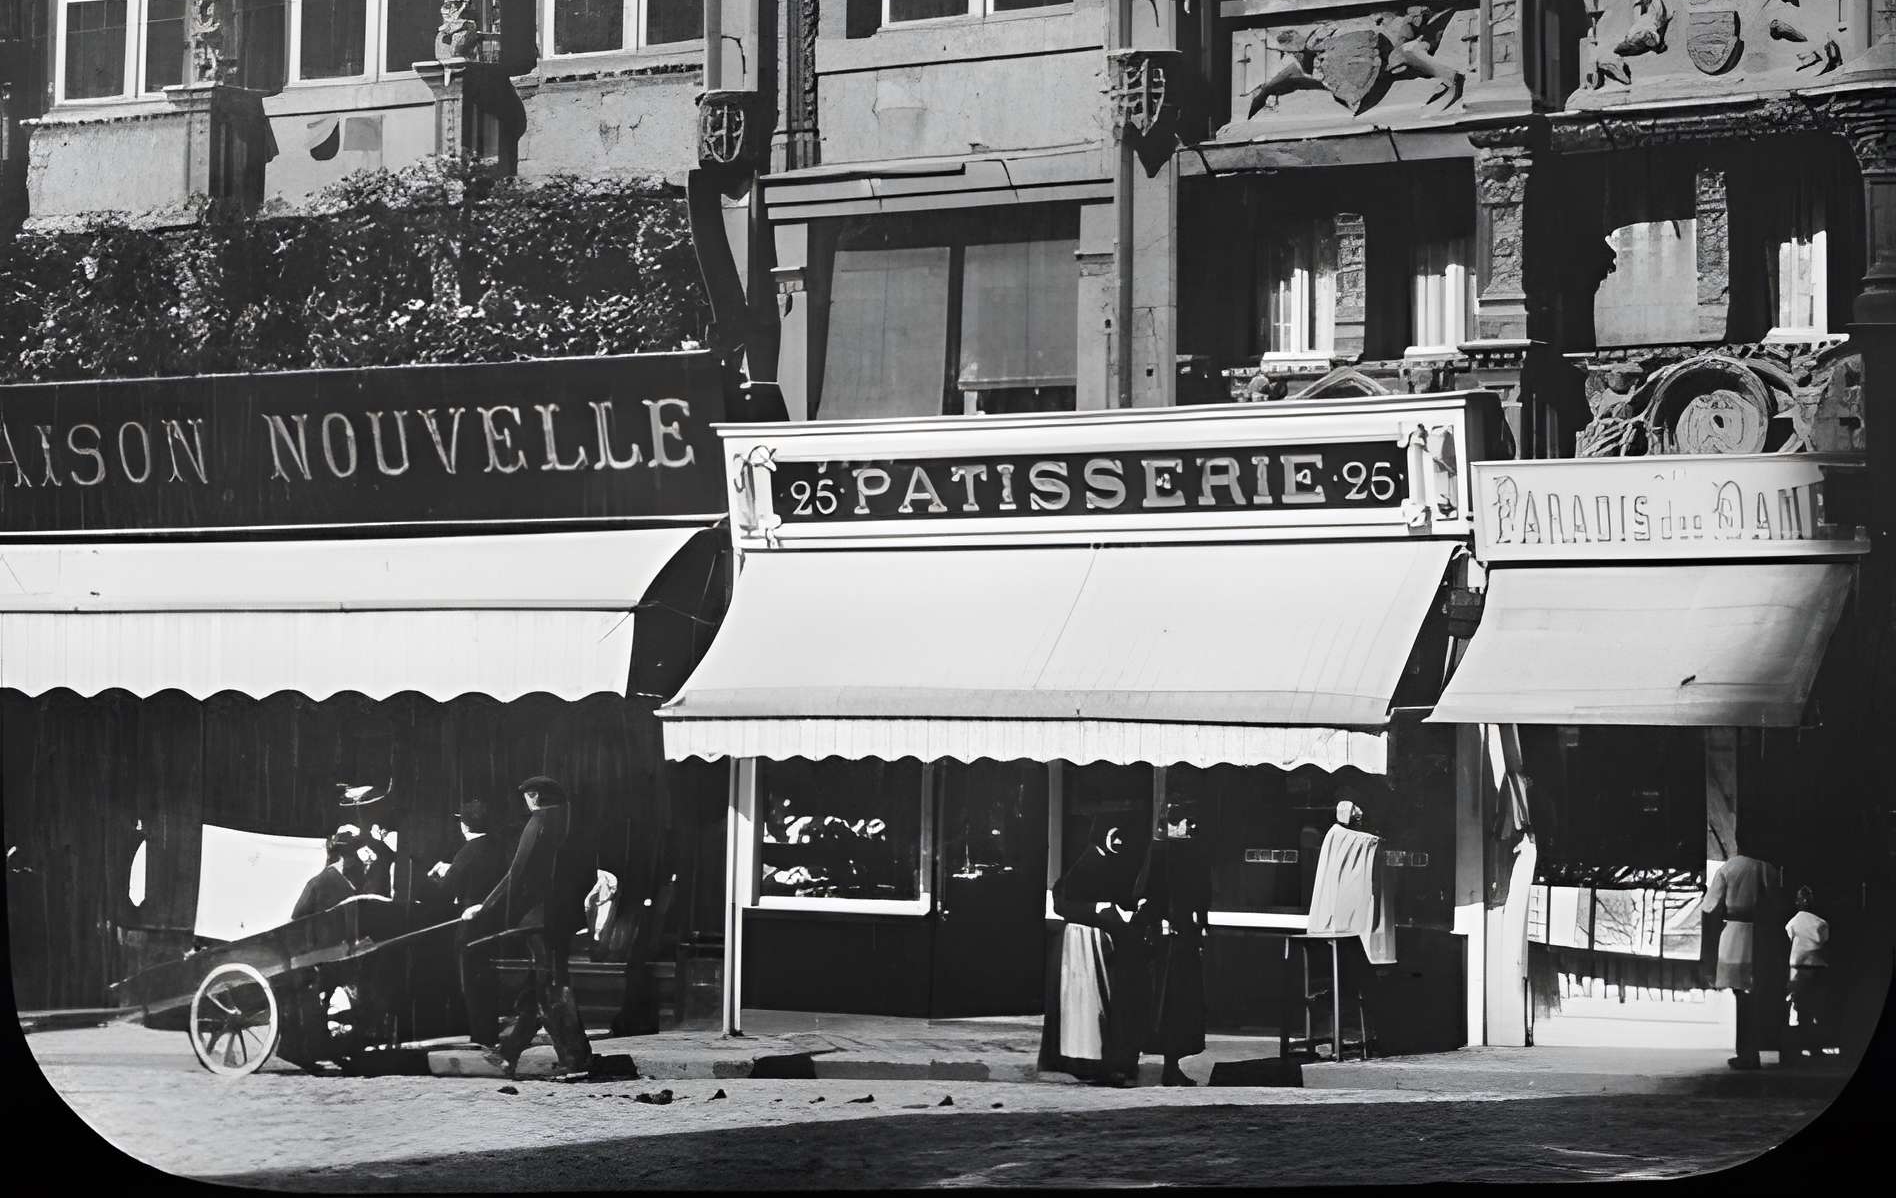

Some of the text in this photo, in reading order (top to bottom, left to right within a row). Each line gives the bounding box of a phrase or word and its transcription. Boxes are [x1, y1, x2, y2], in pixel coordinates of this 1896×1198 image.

[262, 399, 696, 482] NOUVELLE
[790, 453, 1396, 515] 25 PATISSERIE 25
